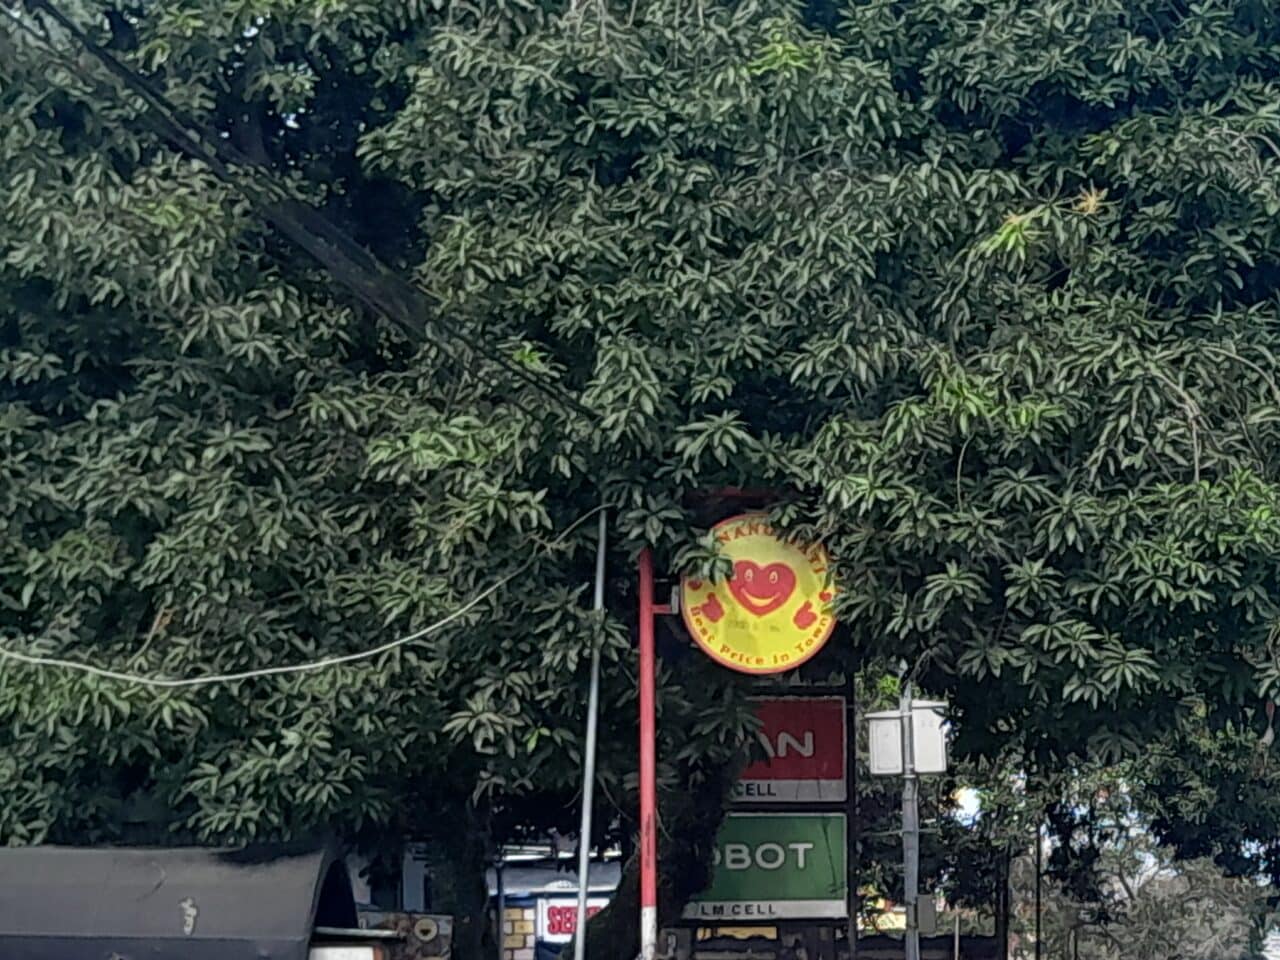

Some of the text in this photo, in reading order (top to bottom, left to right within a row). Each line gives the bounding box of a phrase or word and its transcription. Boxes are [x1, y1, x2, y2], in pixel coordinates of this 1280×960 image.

[690, 606, 716, 643] Best
[720, 644, 764, 665] Price
[795, 616, 829, 653] Town
[713, 843, 814, 870] BOT
[731, 904, 777, 916] CELL
